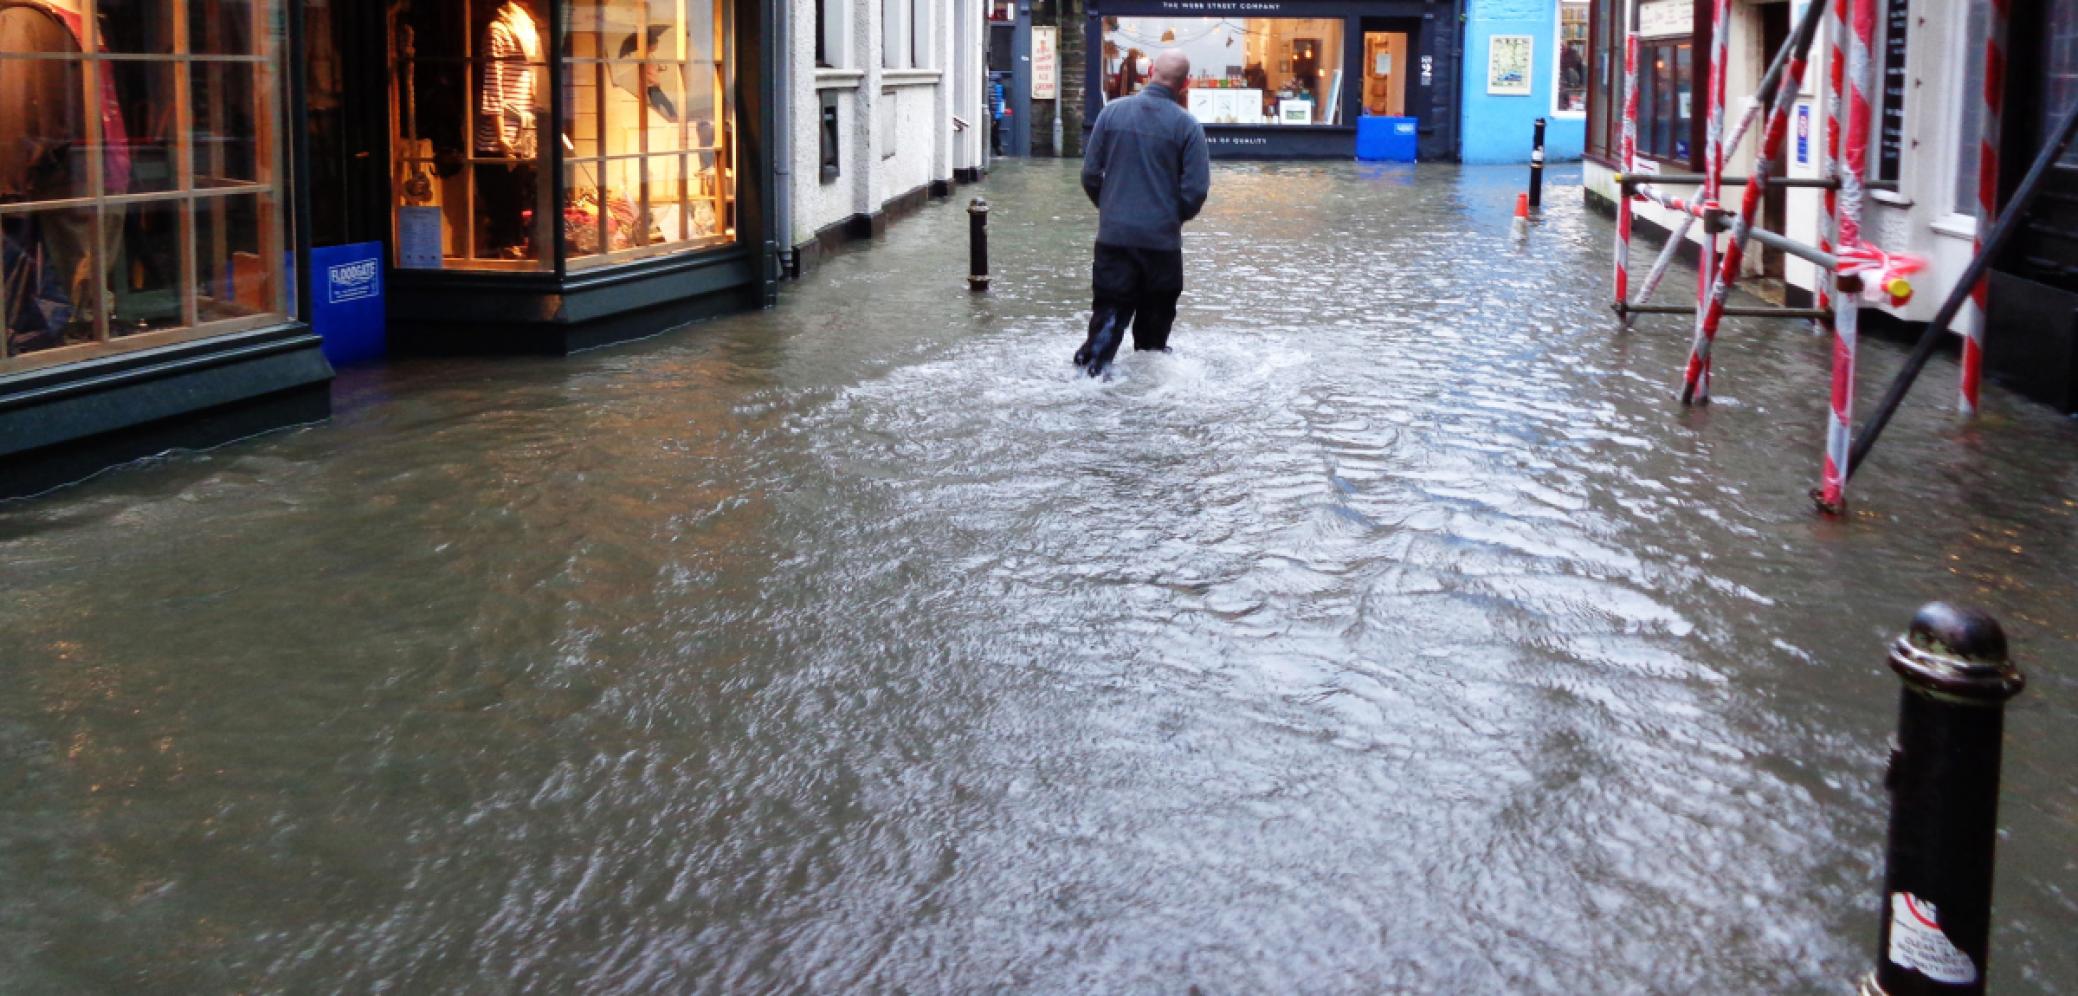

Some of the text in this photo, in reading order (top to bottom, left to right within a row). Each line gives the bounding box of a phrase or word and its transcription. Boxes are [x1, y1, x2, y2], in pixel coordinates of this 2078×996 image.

[1240, 3, 1280, 11] COMPANY
[1233, 137, 1266, 145] QUALITY
[331, 261, 375, 282] FLOODGATE
